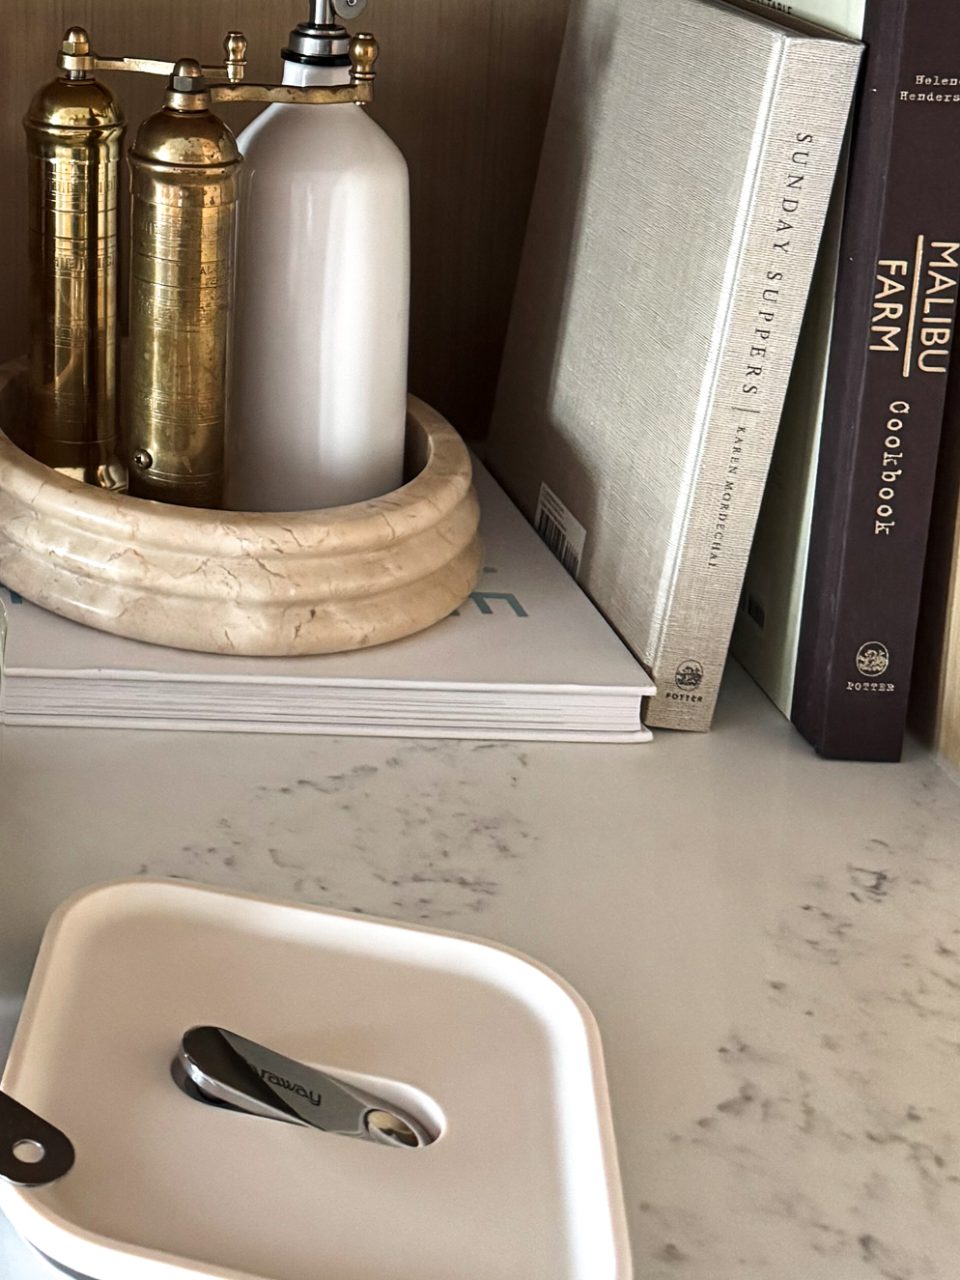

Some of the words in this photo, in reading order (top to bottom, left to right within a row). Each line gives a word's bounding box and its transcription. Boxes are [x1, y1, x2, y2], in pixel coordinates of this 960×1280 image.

[915, 74, 960, 86] Helen
[772, 132, 813, 254] SUNDAY
[742, 270, 783, 395] SUPPERS
[868, 259, 908, 351] FARM
[917, 241, 960, 373] MALIBU
[727, 426, 746, 475] KAREN
[874, 400, 910, 535] Cookbook
[708, 480, 734, 568] MORDECHAI
[665, 692, 703, 702] POTTER
[846, 681, 895, 692] POTTER
[248, 1064, 322, 1107] raway
